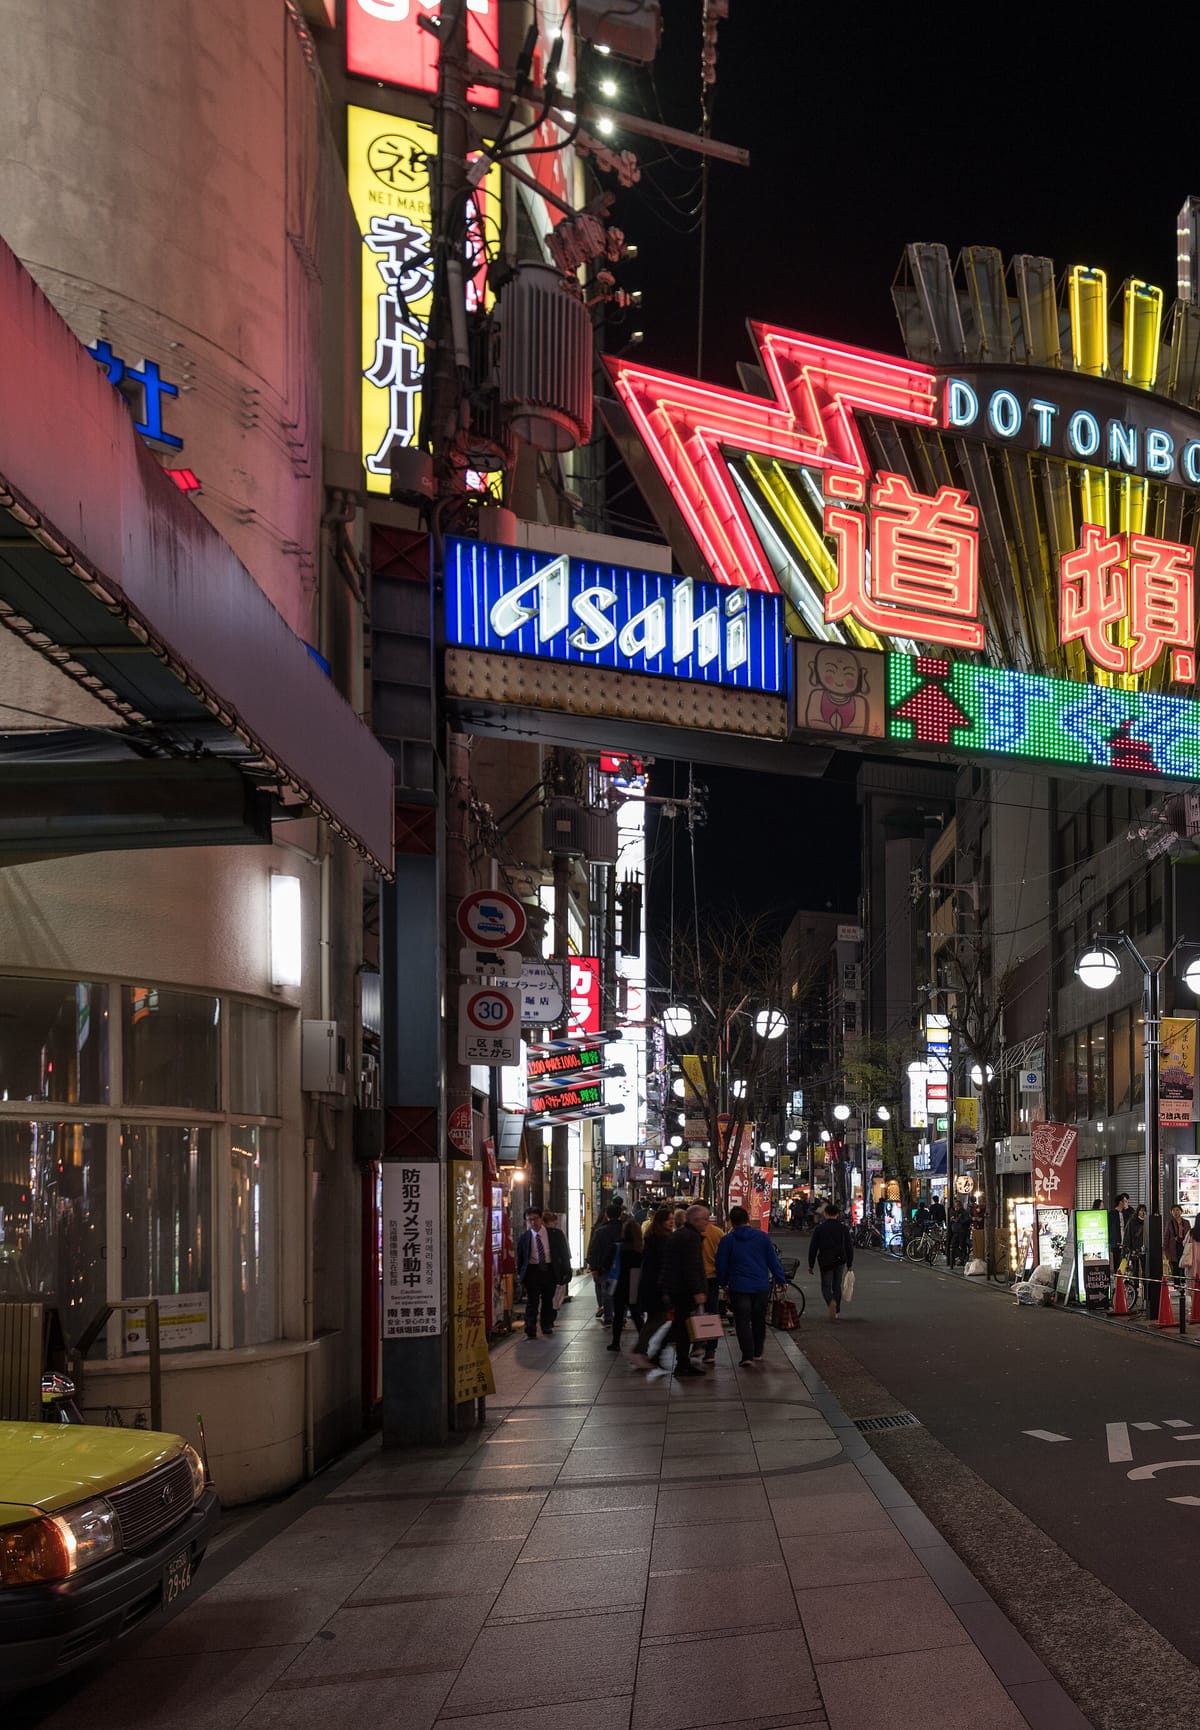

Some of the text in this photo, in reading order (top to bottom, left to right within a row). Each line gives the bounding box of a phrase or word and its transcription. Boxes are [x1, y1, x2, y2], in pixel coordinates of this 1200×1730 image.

[369, 190, 394, 206] NET
[490, 554, 748, 672] Asahi
[479, 1002, 503, 1019] 30
[477, 1038, 503, 1048] 区域
[468, 1048, 512, 1058] ここから
[402, 1169, 421, 1288] 防犯カメラ作動中
